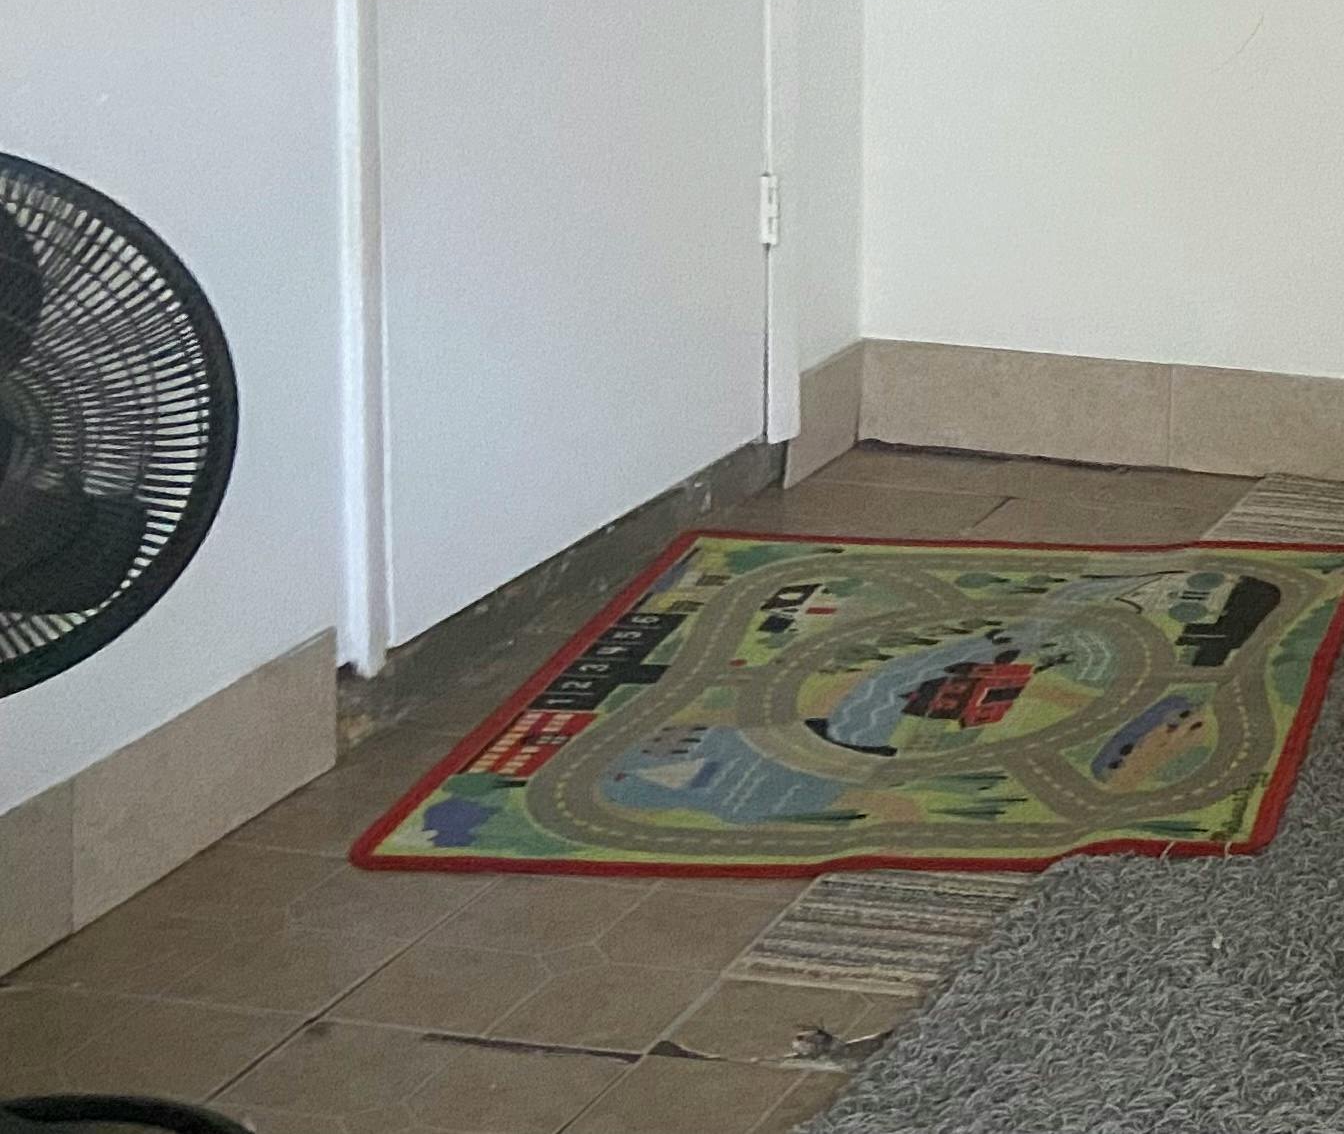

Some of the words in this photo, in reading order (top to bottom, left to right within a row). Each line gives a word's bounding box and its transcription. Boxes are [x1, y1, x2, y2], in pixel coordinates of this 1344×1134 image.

[561, 681, 593, 689] 2
[578, 663, 609, 672] 3
[613, 630, 643, 639] 5
[631, 615, 660, 624] 6
